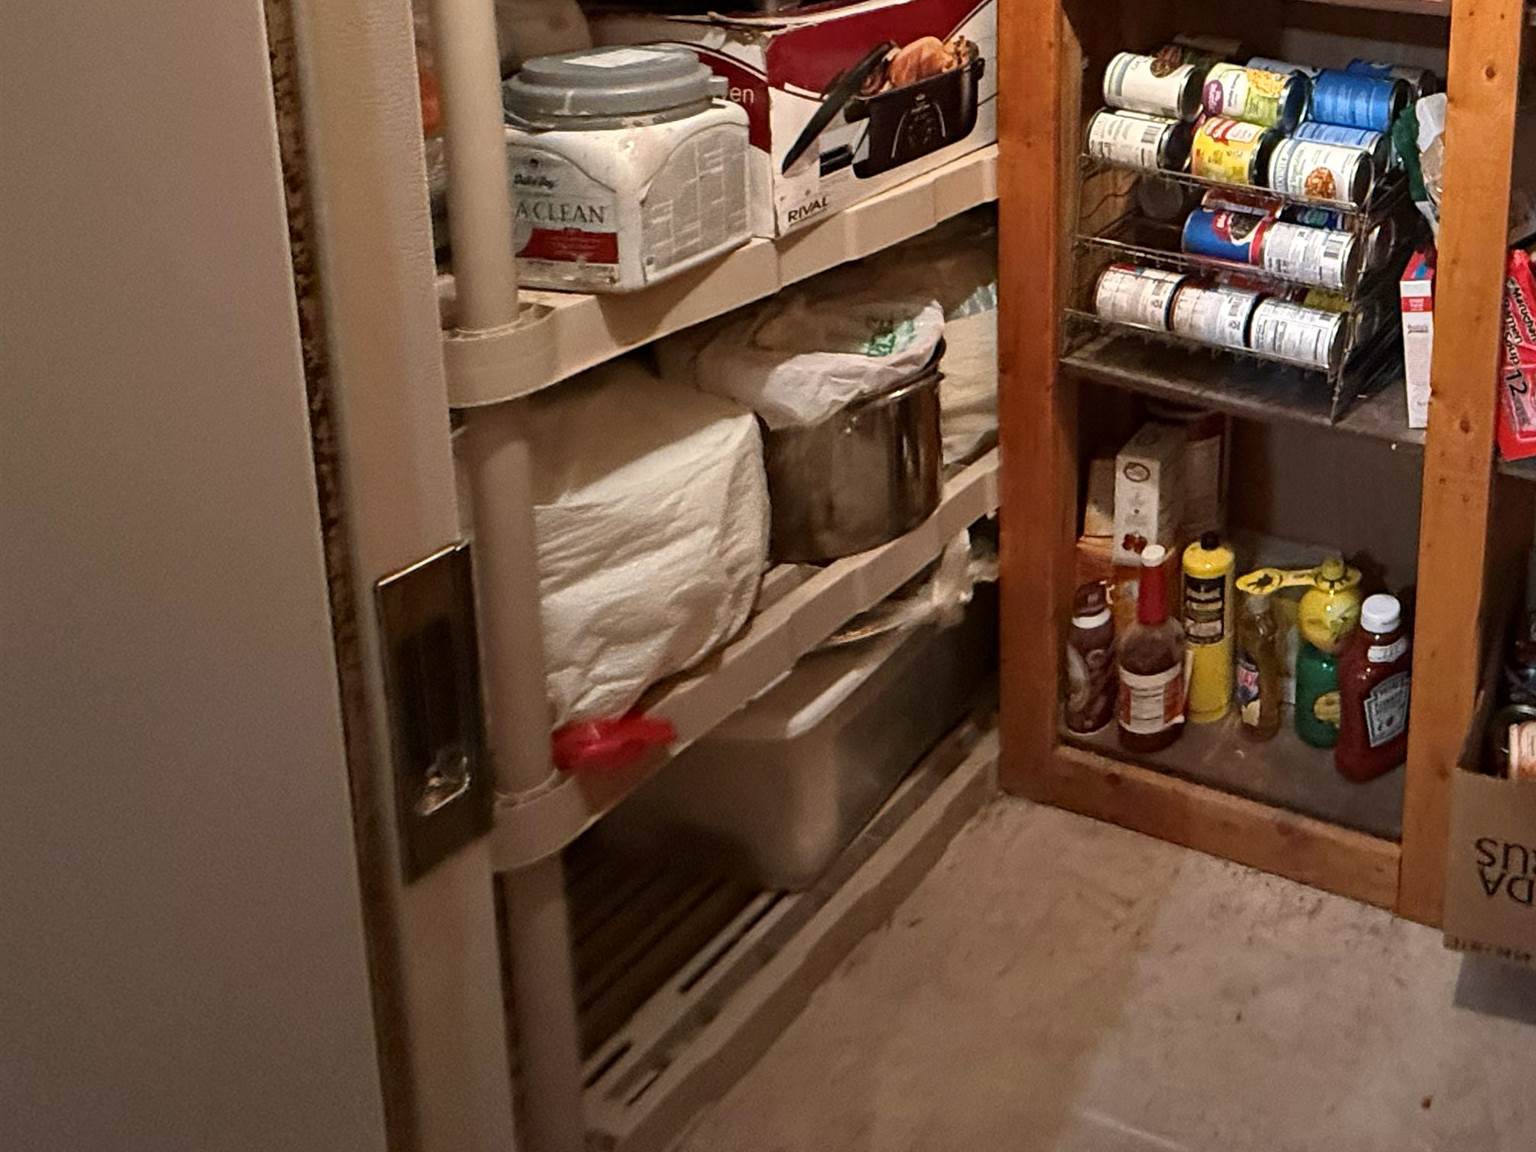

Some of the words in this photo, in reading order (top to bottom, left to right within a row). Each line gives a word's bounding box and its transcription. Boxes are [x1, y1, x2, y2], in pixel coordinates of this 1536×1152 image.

[514, 202, 605, 224] ACLEAN
[788, 196, 829, 223] RIVAL
[1505, 369, 1528, 397] 12
